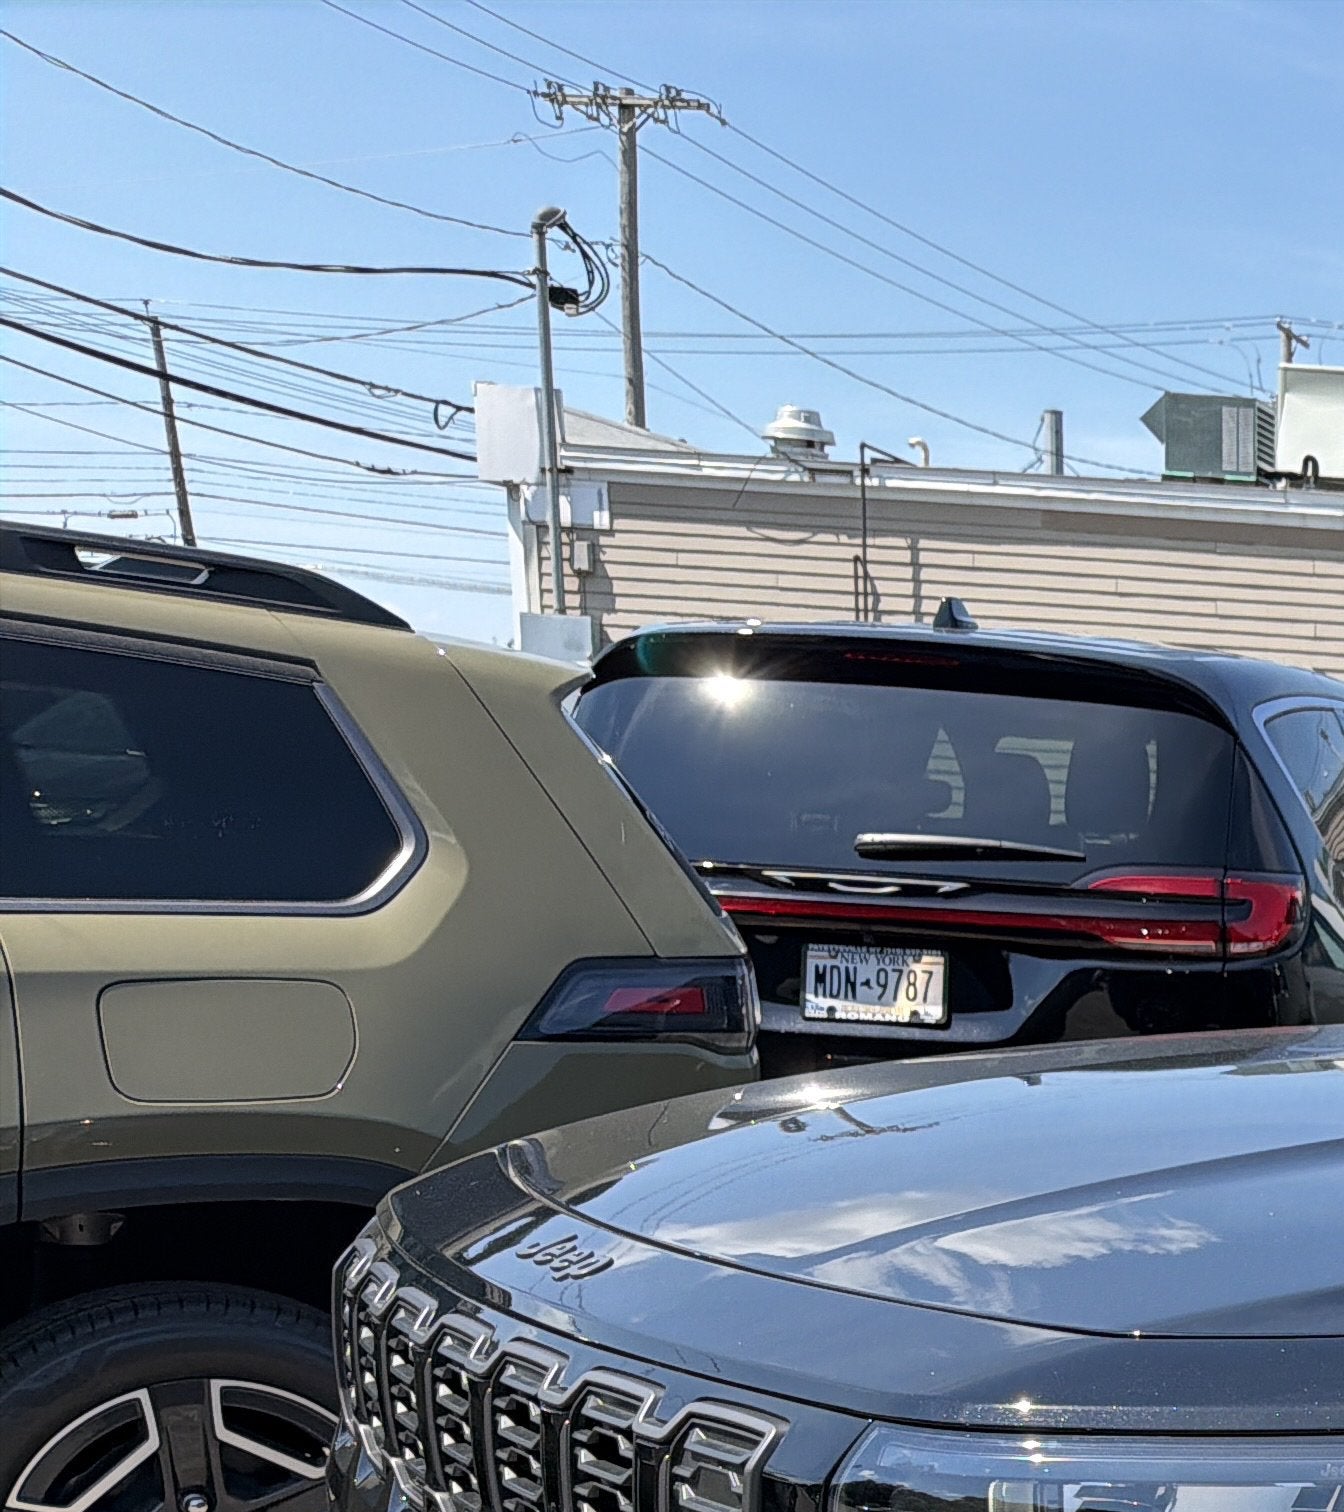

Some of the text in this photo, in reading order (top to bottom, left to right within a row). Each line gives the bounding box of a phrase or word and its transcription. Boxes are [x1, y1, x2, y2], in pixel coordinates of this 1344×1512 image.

[839, 951, 910, 968] NEW YORK
[876, 967, 934, 1004] 9787
[515, 1233, 615, 1282] Jeep
